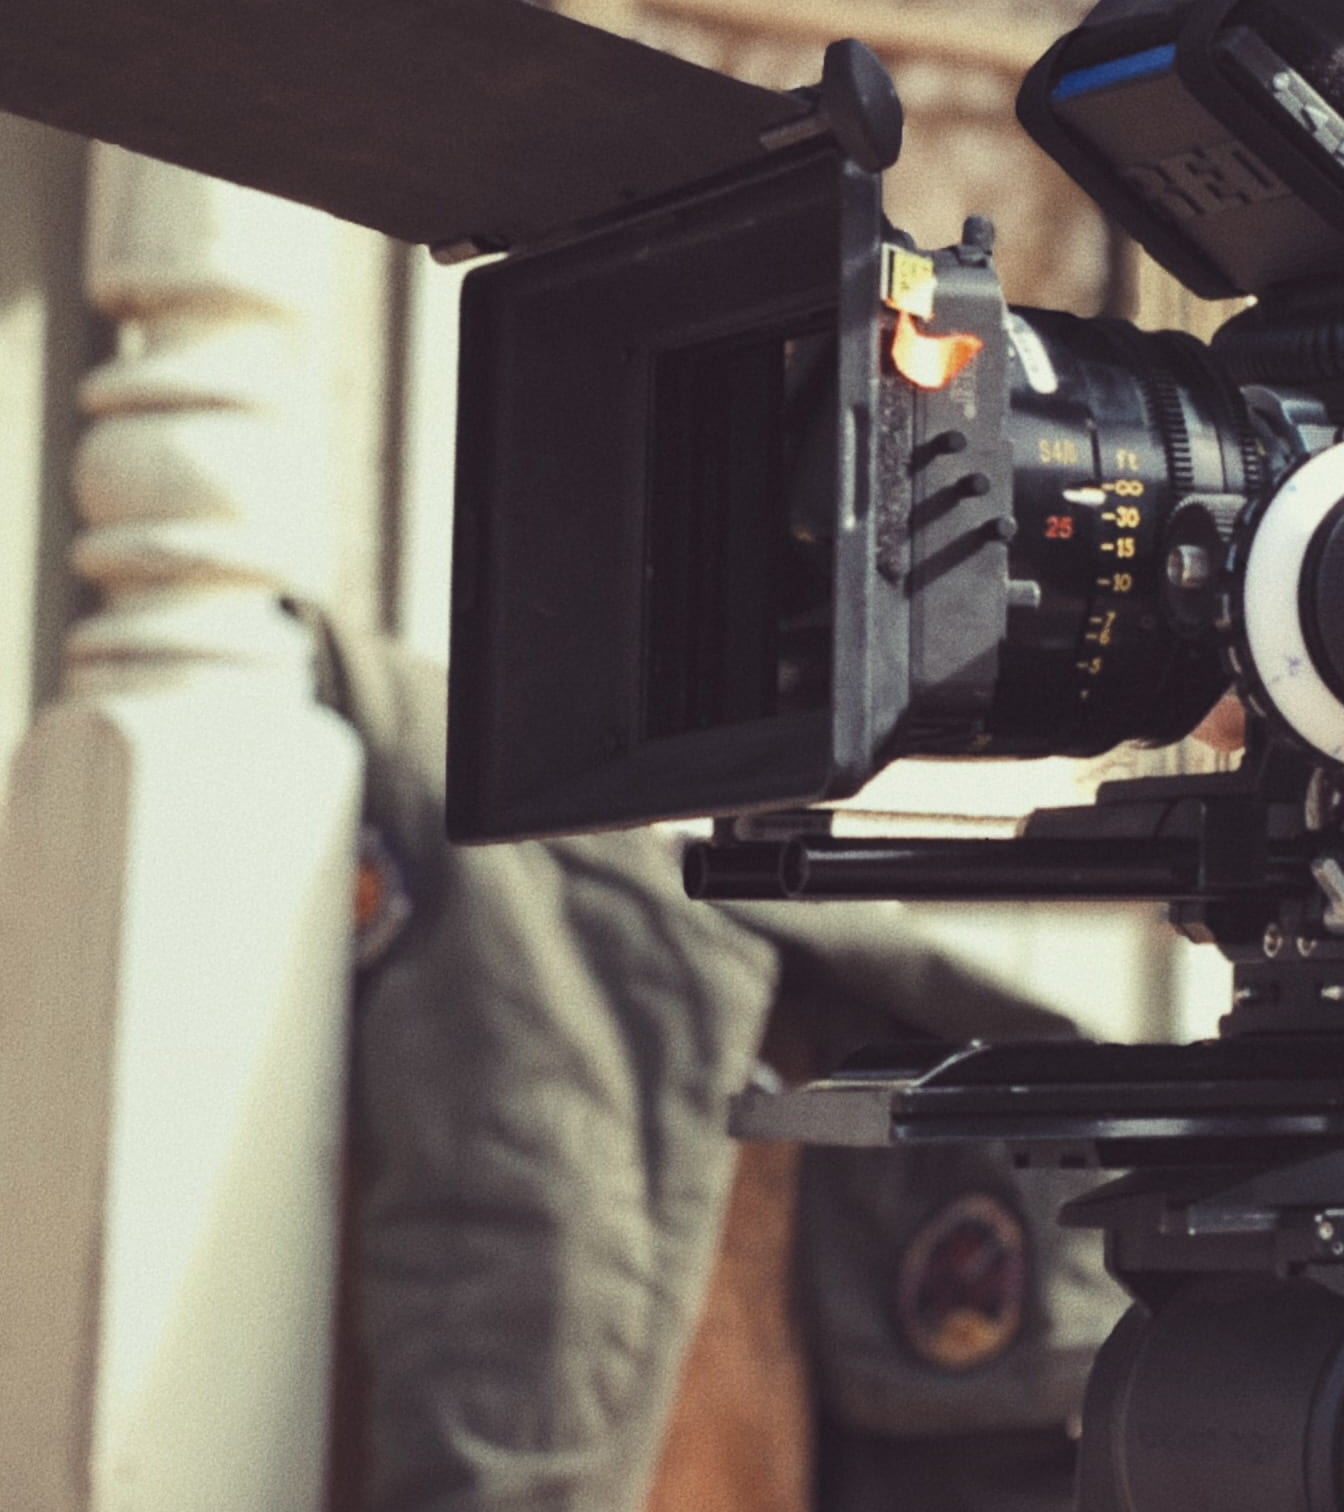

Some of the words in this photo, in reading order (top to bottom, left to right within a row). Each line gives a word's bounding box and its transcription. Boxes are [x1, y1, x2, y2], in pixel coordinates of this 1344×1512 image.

[1045, 515, 1074, 538] 25
[1116, 506, 1140, 528] 30
[1117, 537, 1135, 558] 15
[1113, 573, 1132, 592] 10
